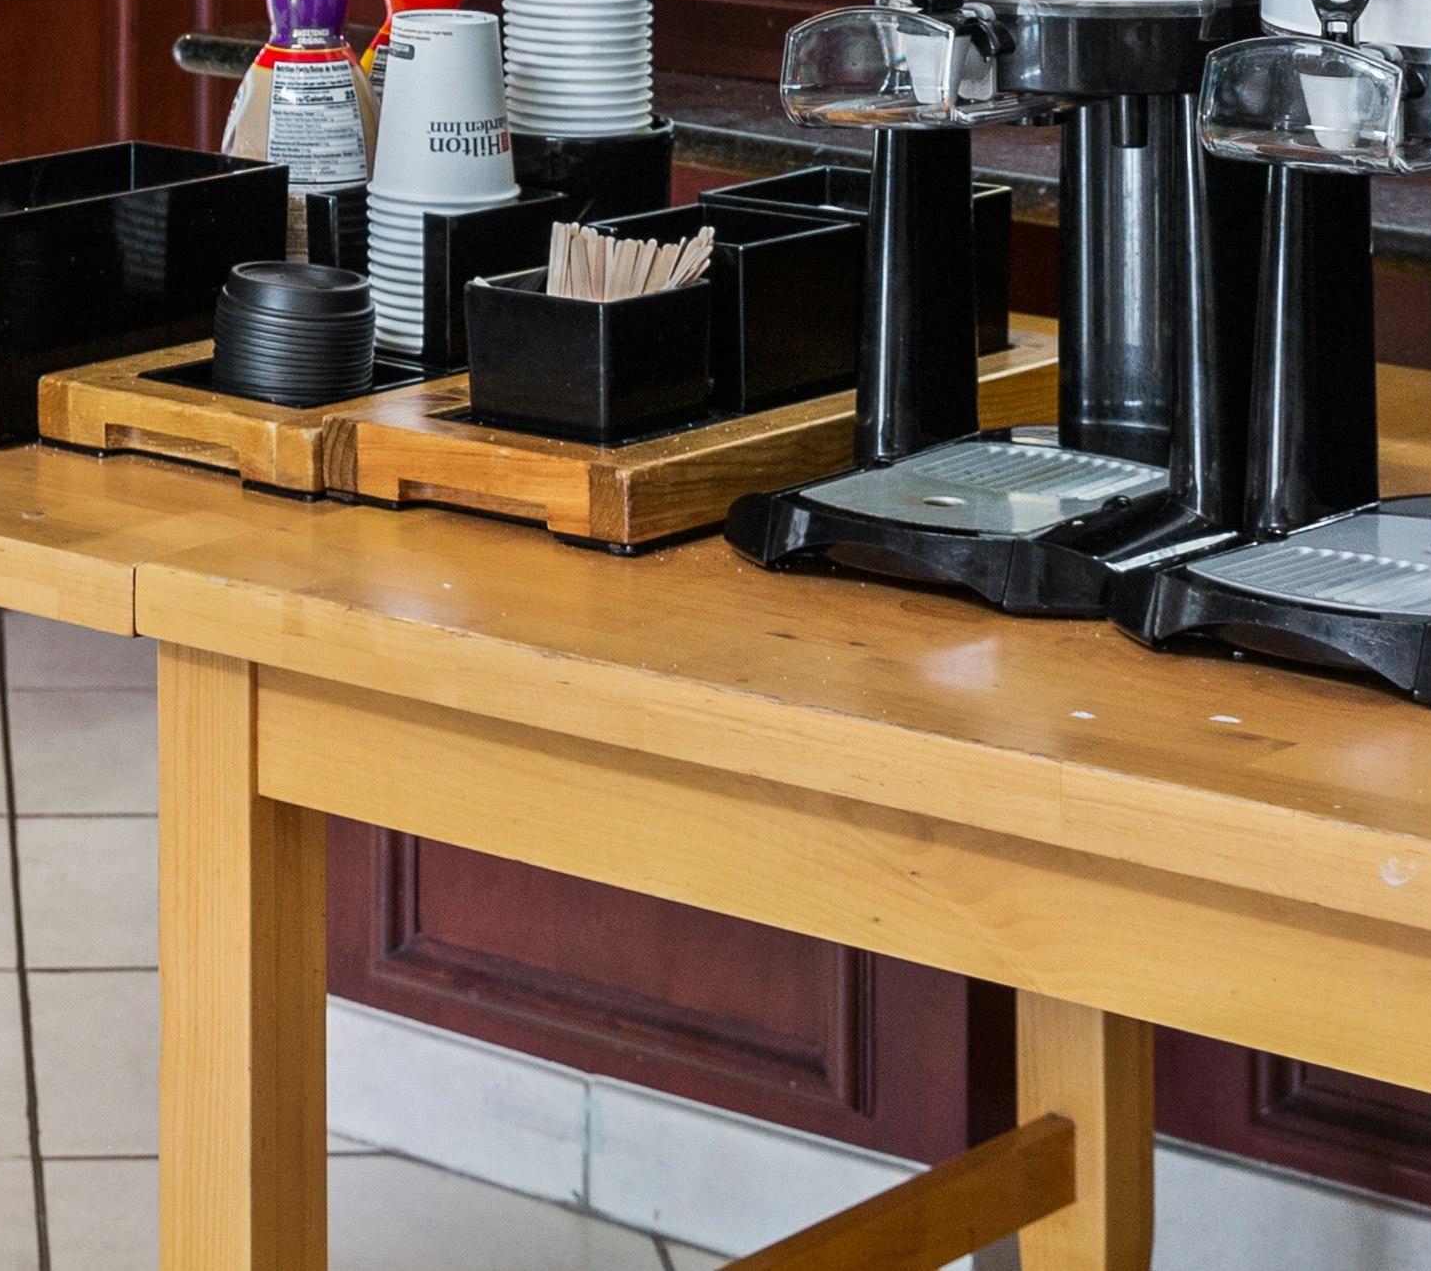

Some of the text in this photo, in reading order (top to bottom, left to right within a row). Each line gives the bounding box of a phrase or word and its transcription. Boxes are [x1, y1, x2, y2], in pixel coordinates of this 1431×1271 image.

[429, 116, 507, 136] arden Inn
[429, 133, 501, 157] Hilton
